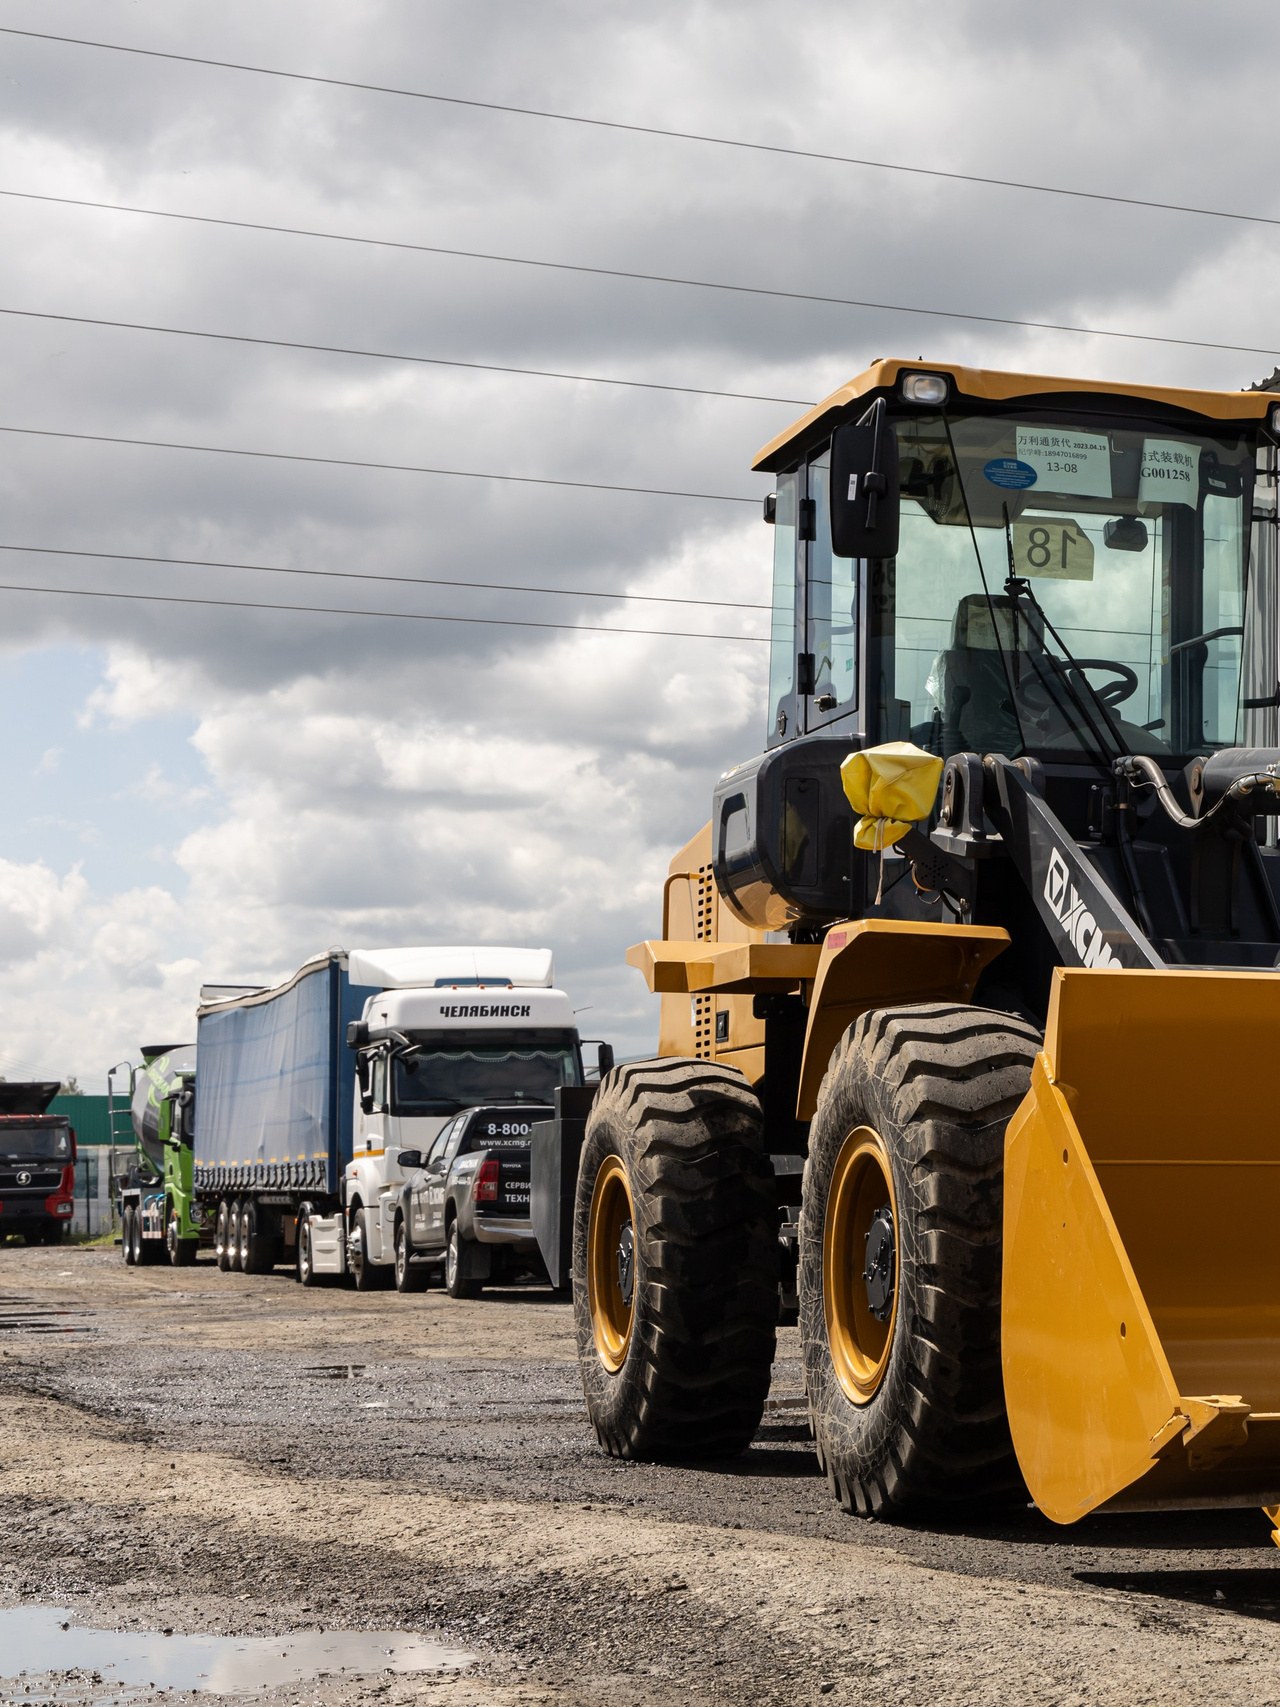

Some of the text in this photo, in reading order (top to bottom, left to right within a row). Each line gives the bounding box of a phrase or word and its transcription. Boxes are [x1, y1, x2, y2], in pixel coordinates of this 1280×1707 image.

[1018, 435, 1107, 451] 万利通货代 2023.04.19
[1047, 462, 1078, 473] 13-08
[1141, 467, 1191, 482] G001258
[439, 1005, 531, 1018] ЧЕЛЯБИНСК
